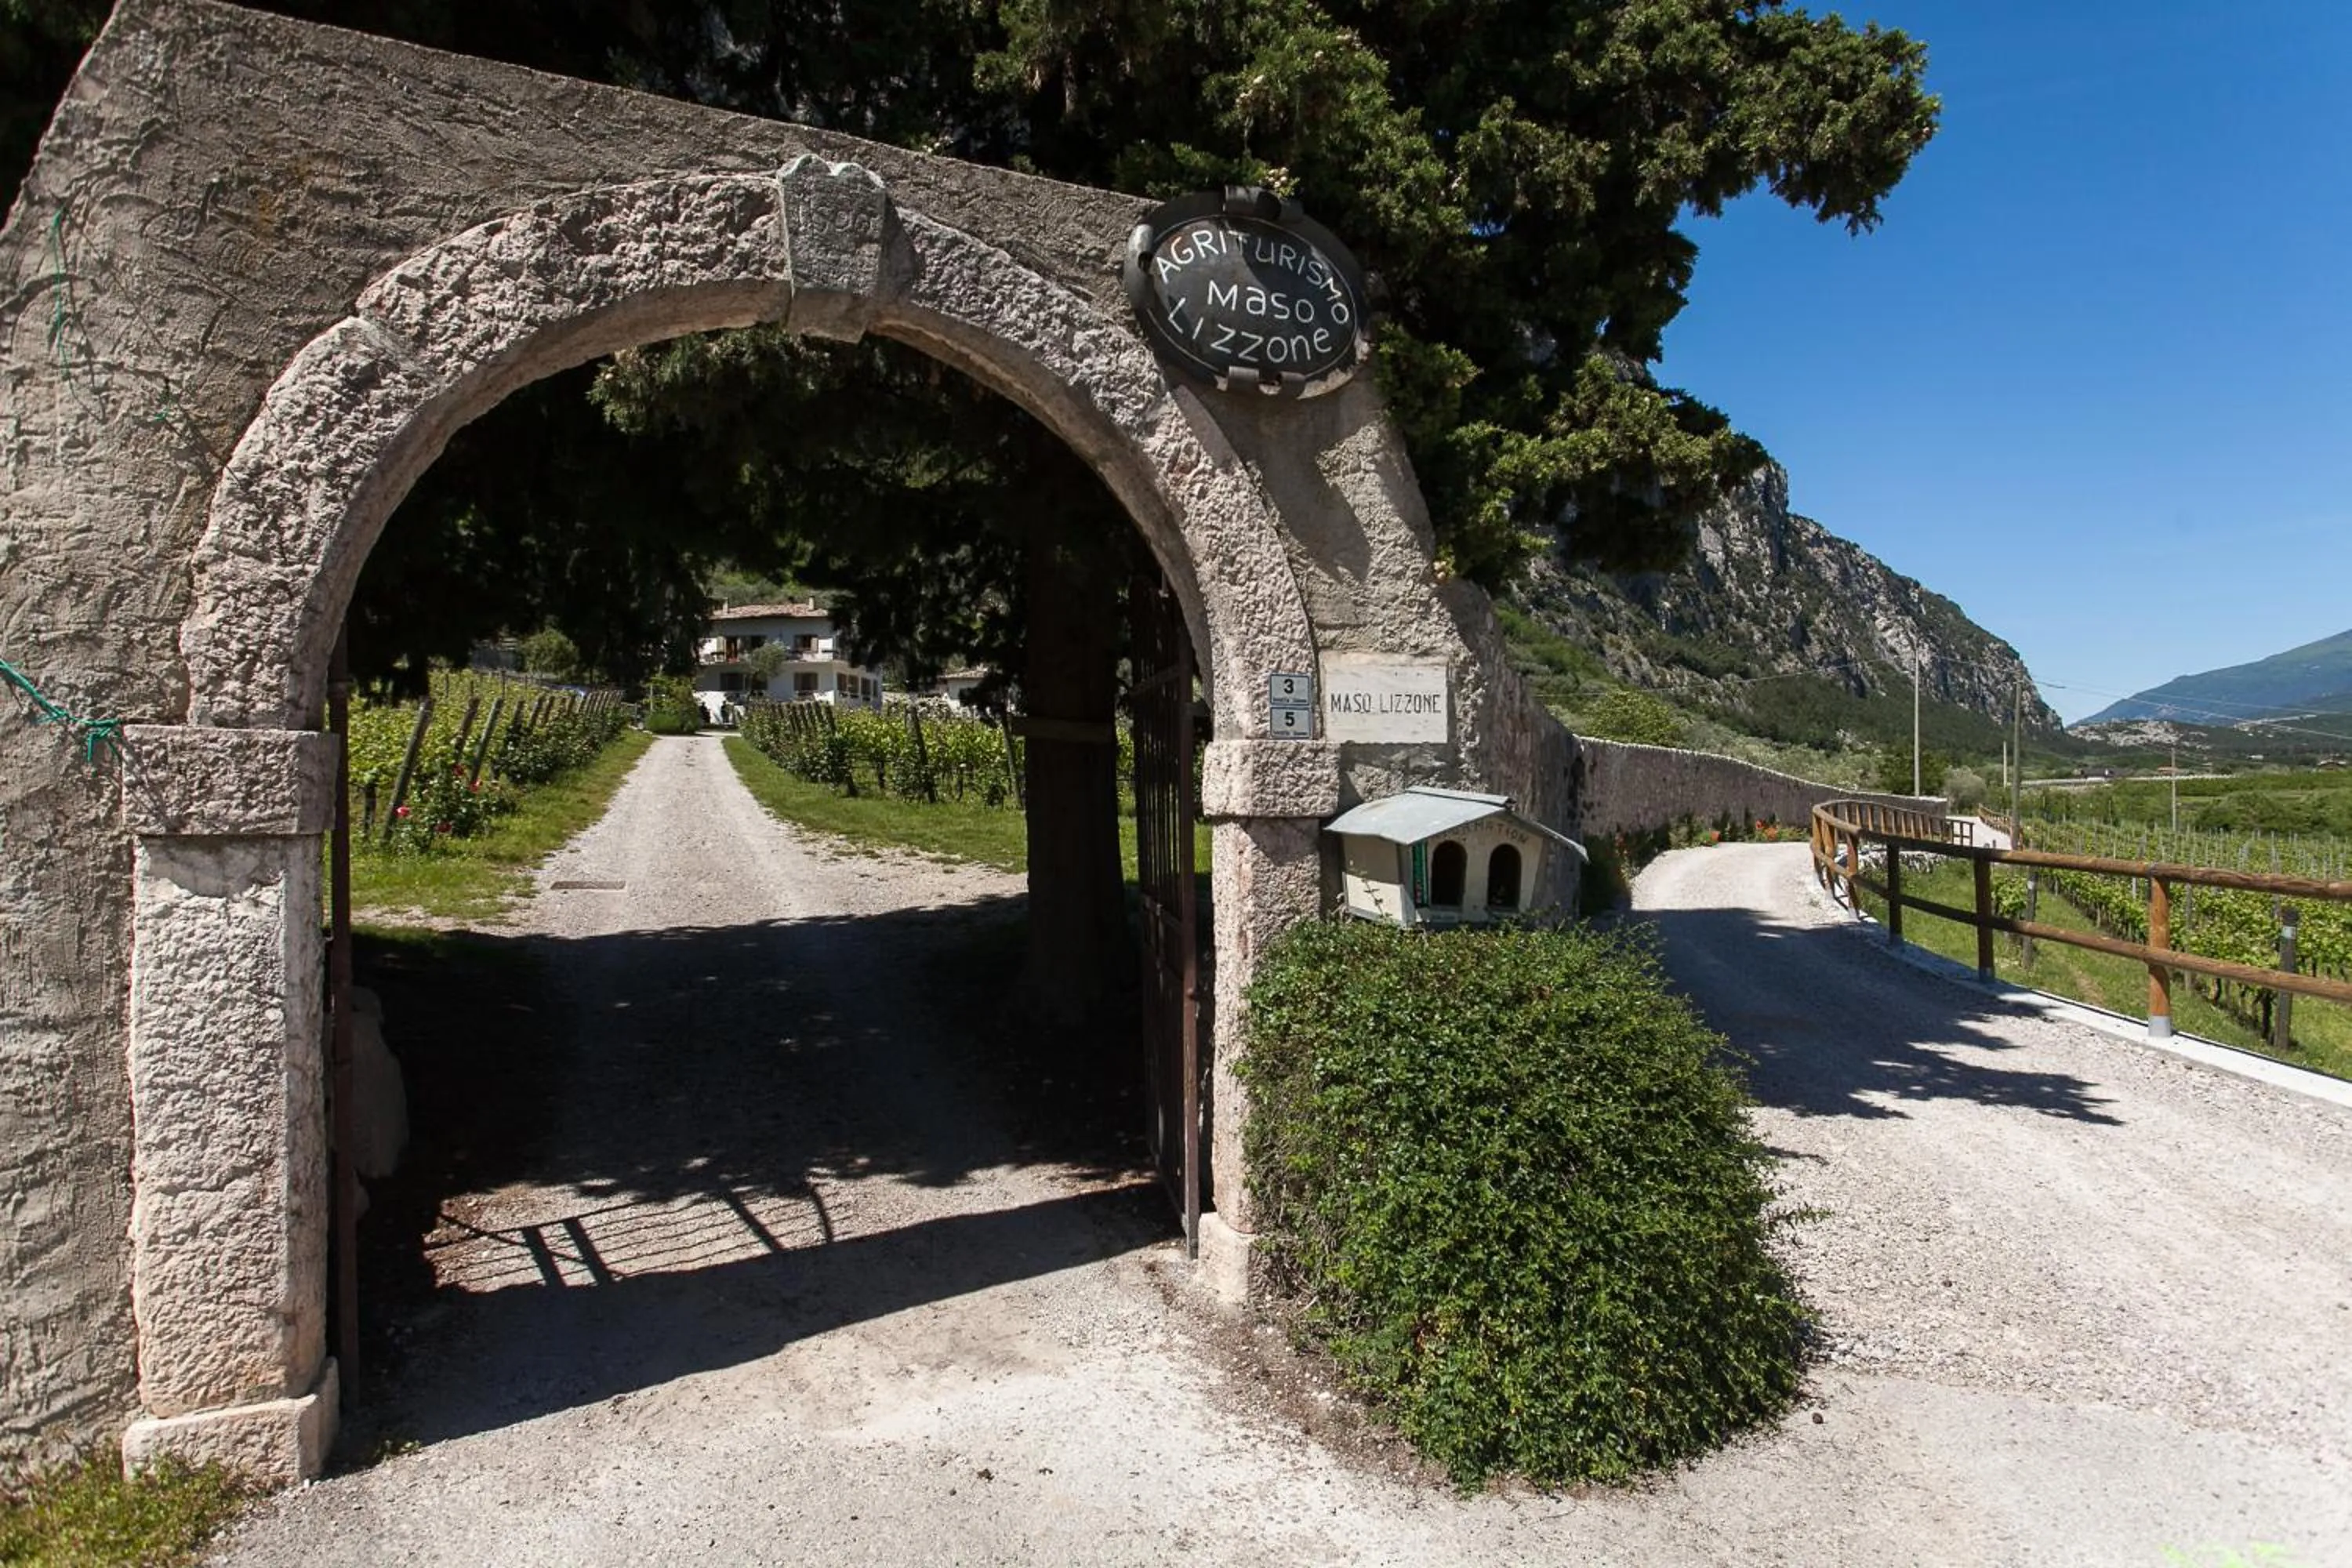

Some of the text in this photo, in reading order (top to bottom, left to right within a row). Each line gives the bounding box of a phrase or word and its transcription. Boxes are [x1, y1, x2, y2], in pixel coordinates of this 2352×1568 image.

[1154, 230, 1350, 325] AGRITURISMO
[1207, 280, 1316, 324] Maso
[1283, 678, 1294, 695] 3
[1330, 692, 1443, 714] MASO LIZZONE
[1284, 711, 1295, 728] 5
